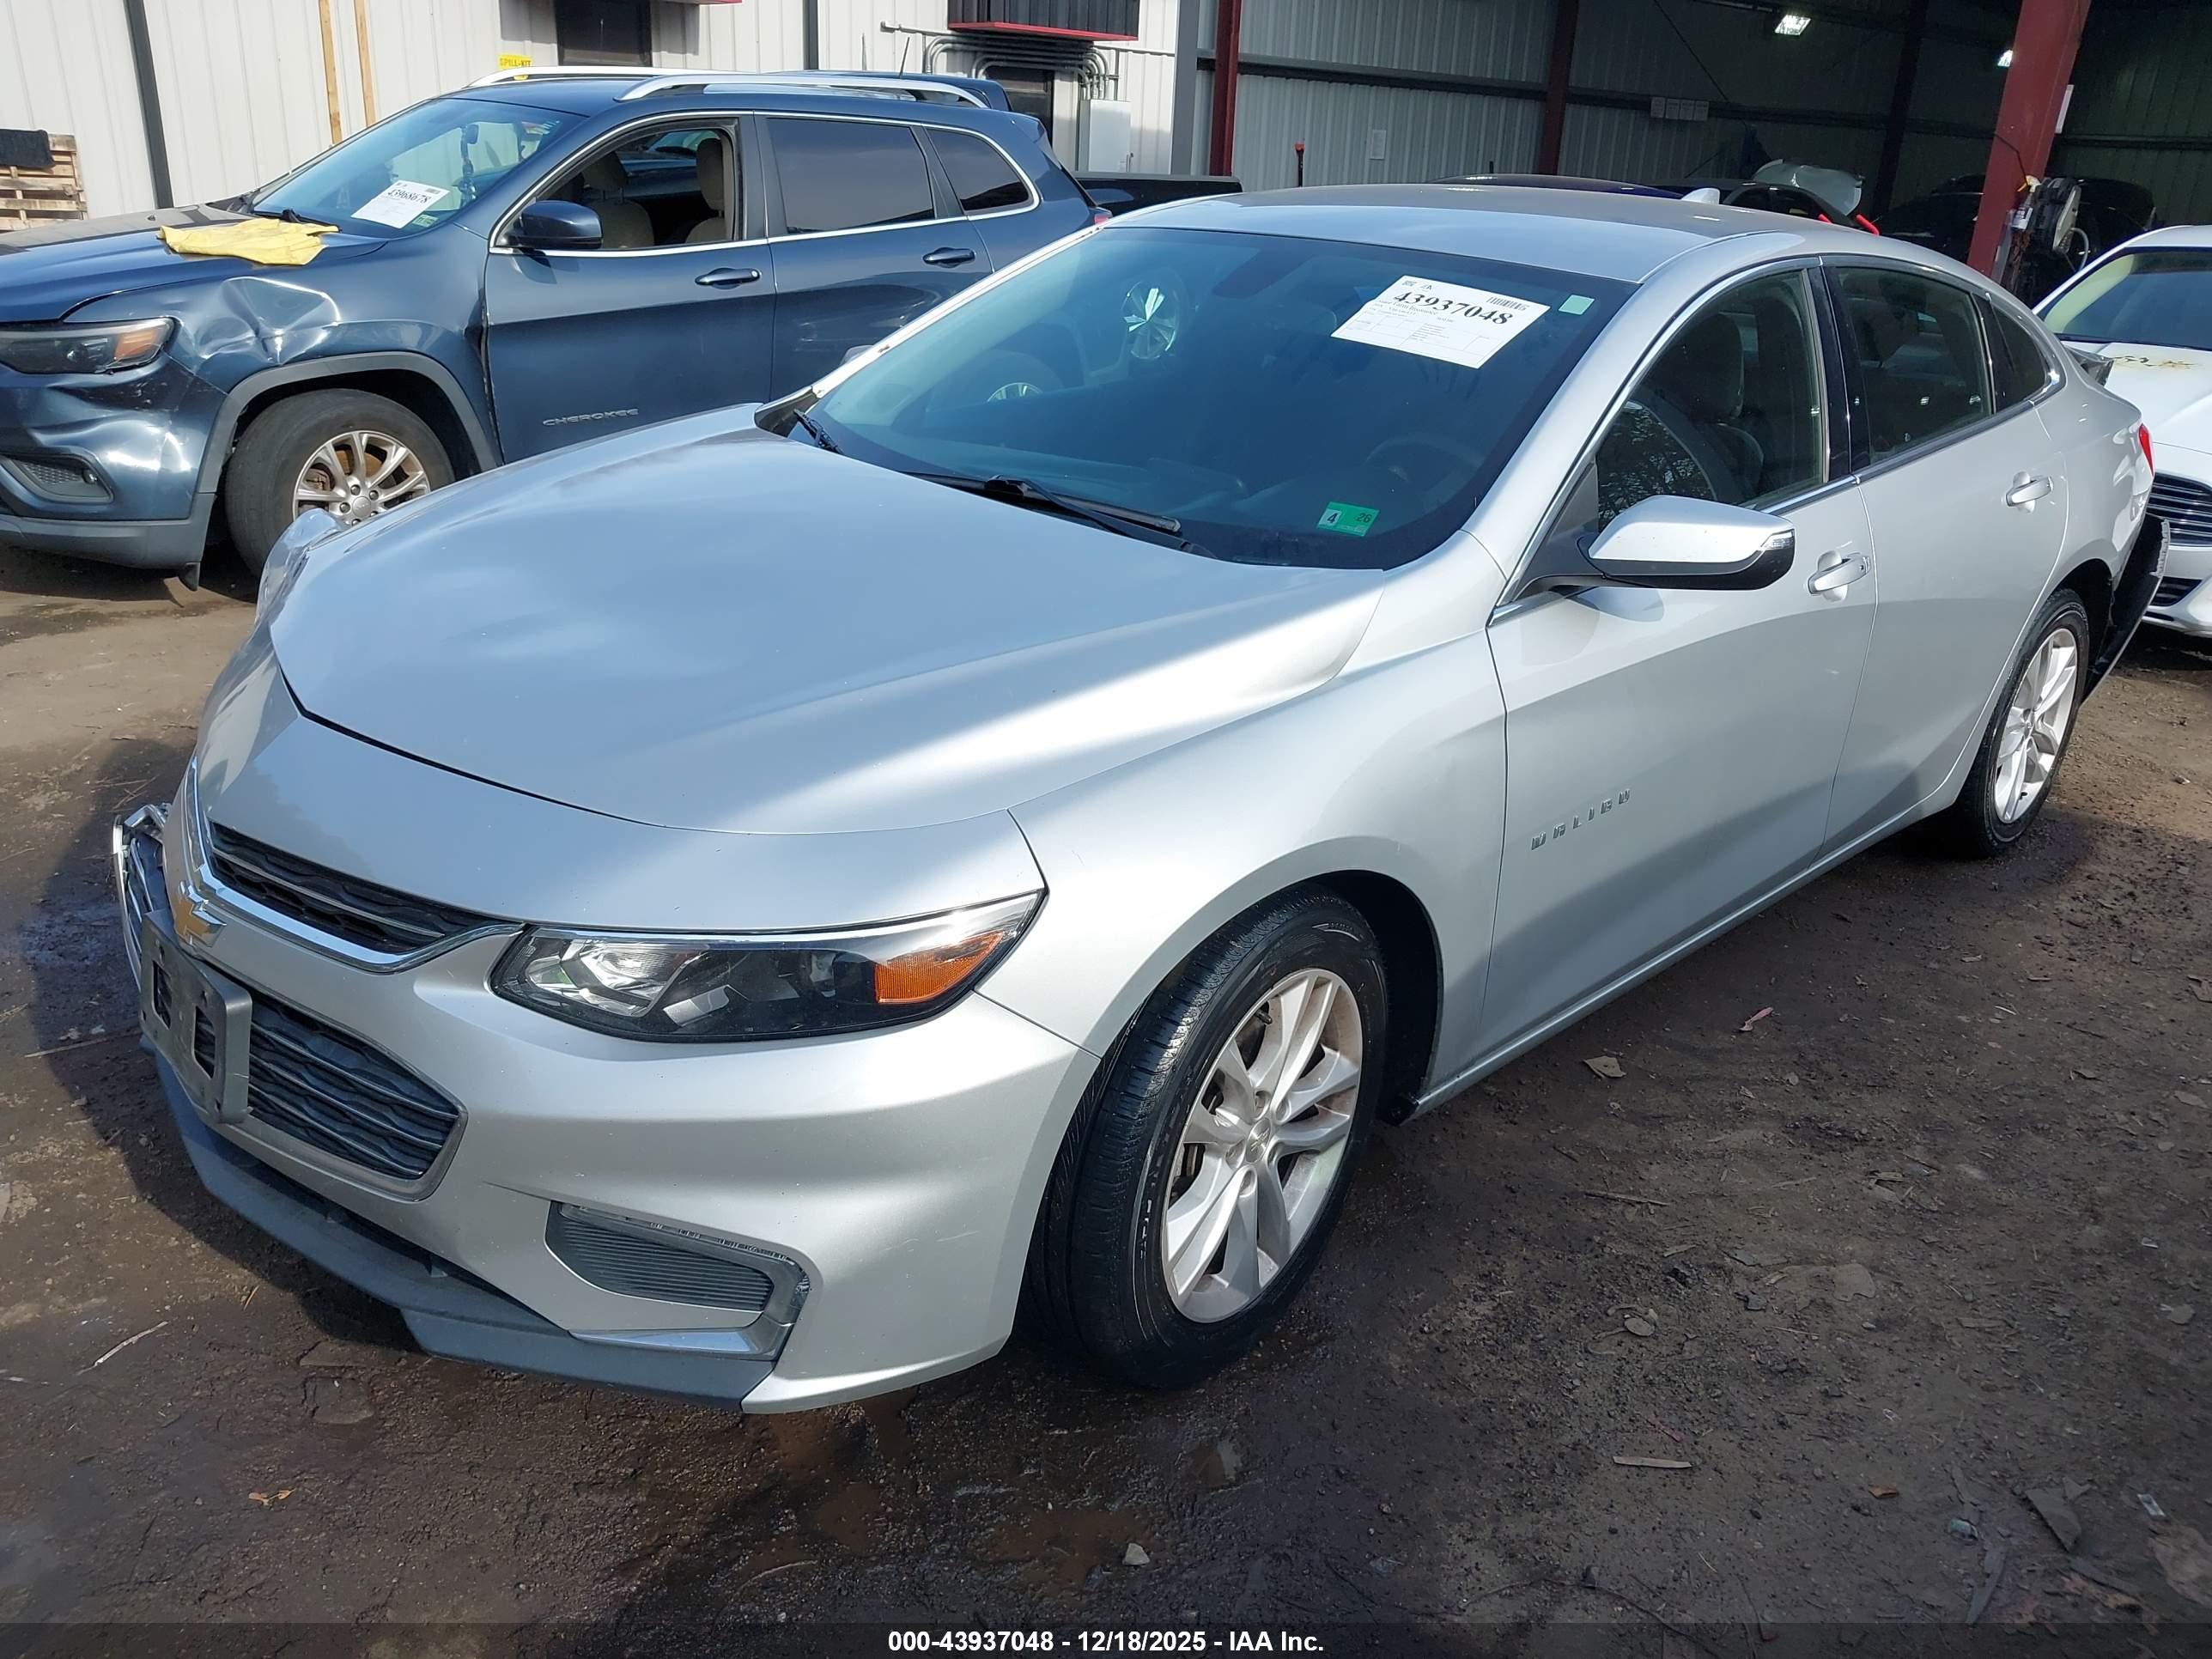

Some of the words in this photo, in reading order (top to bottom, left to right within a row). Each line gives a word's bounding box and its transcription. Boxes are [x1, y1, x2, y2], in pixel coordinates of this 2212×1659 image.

[1394, 291, 1514, 325] 43937048
[542, 408, 639, 425] CHEROKEE
[1327, 513, 1338, 523] 4
[1356, 513, 1373, 523] 26
[1531, 788, 1631, 851] MALIBU
